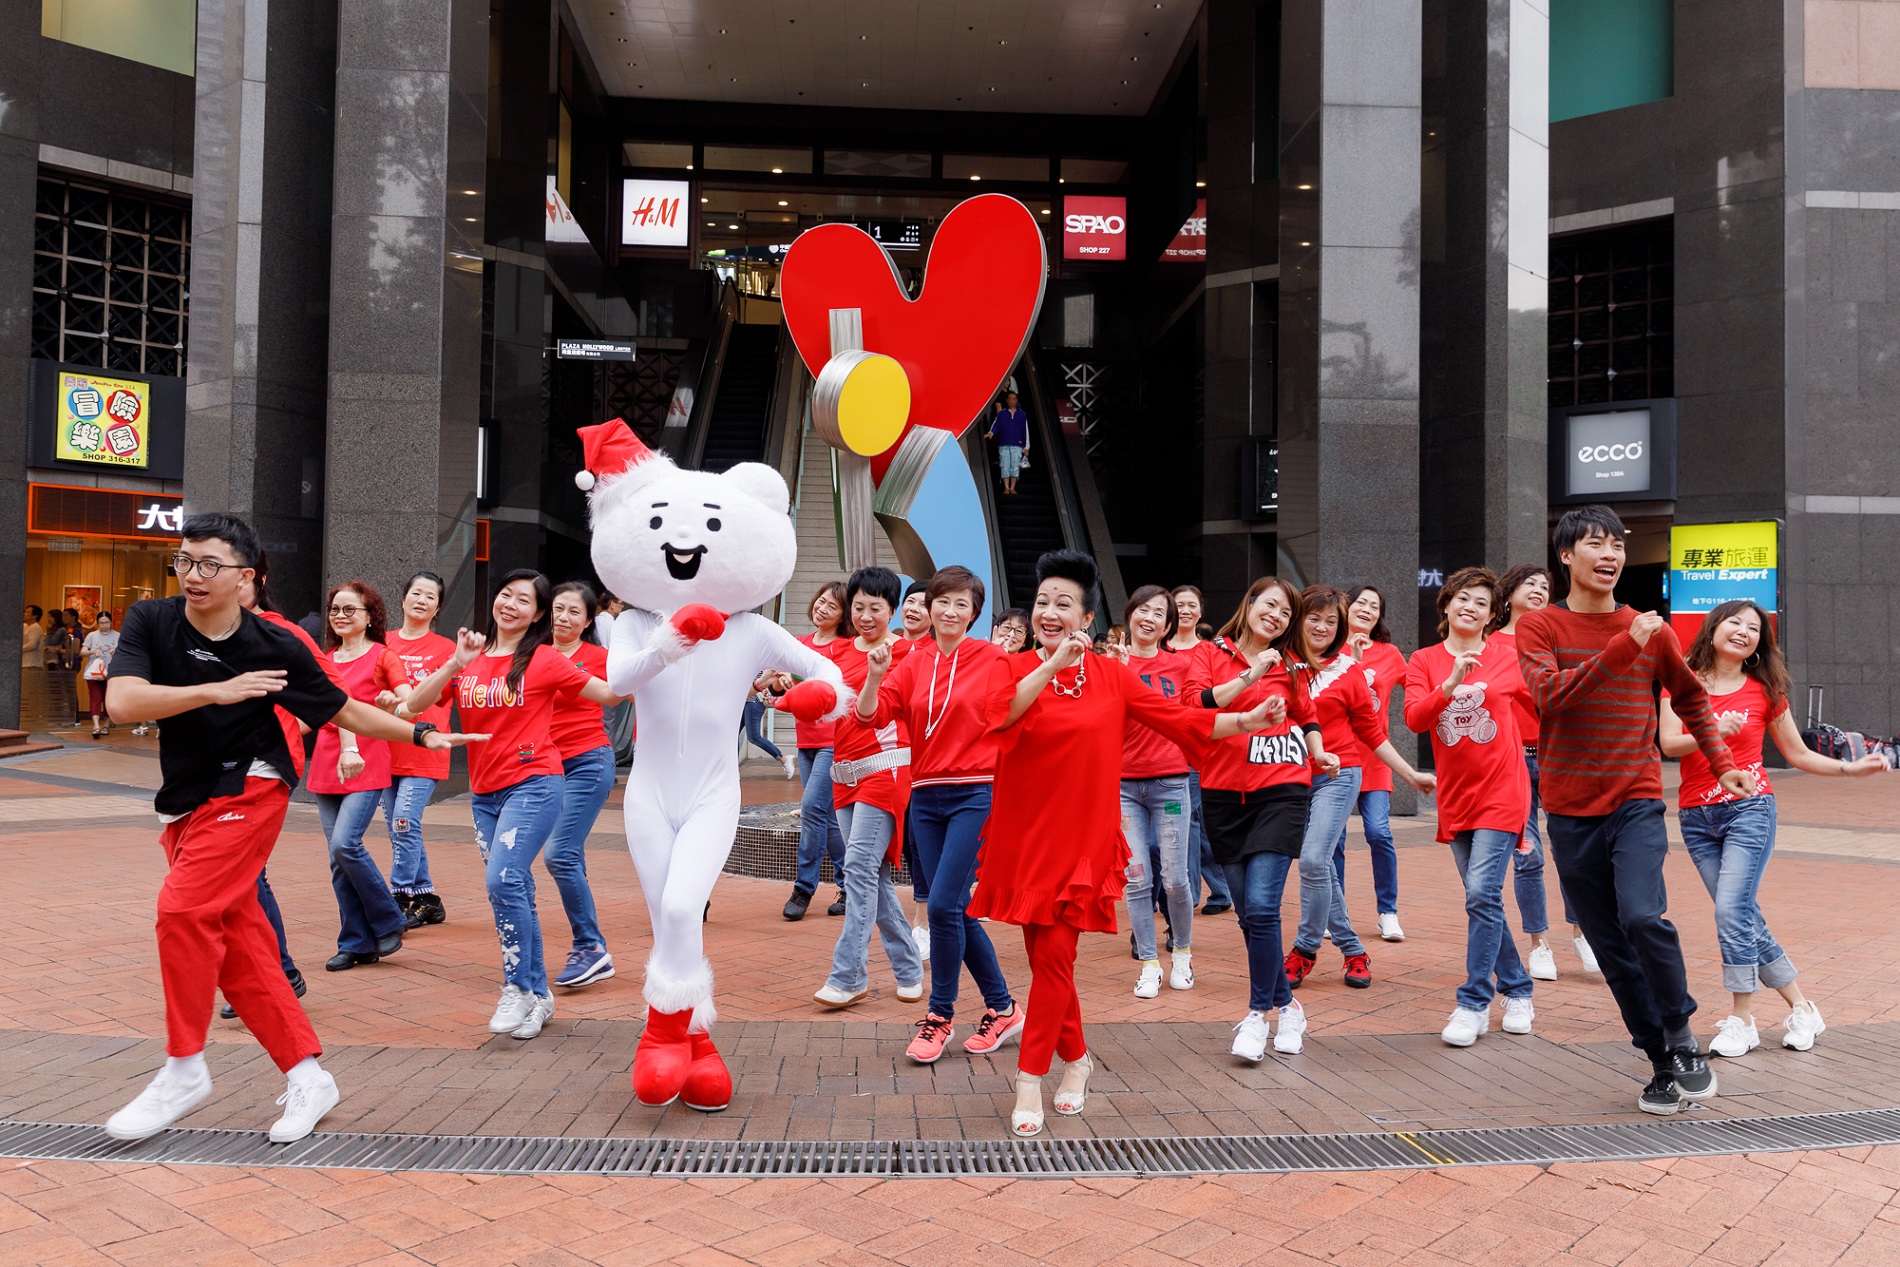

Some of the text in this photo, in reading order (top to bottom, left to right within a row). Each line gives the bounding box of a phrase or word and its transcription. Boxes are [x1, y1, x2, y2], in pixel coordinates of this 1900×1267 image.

[632, 197, 680, 228] H&M
[1065, 214, 1125, 234] SPAO
[874, 226, 882, 239] 1
[1079, 246, 1098, 254] SHOP
[1578, 441, 1643, 463] ecco
[82, 453, 141, 465] SHOP 316-317
[1681, 547, 1768, 569] 專業旅運
[1681, 569, 1768, 582] Travel Expert
[1453, 715, 1473, 725] TOY
